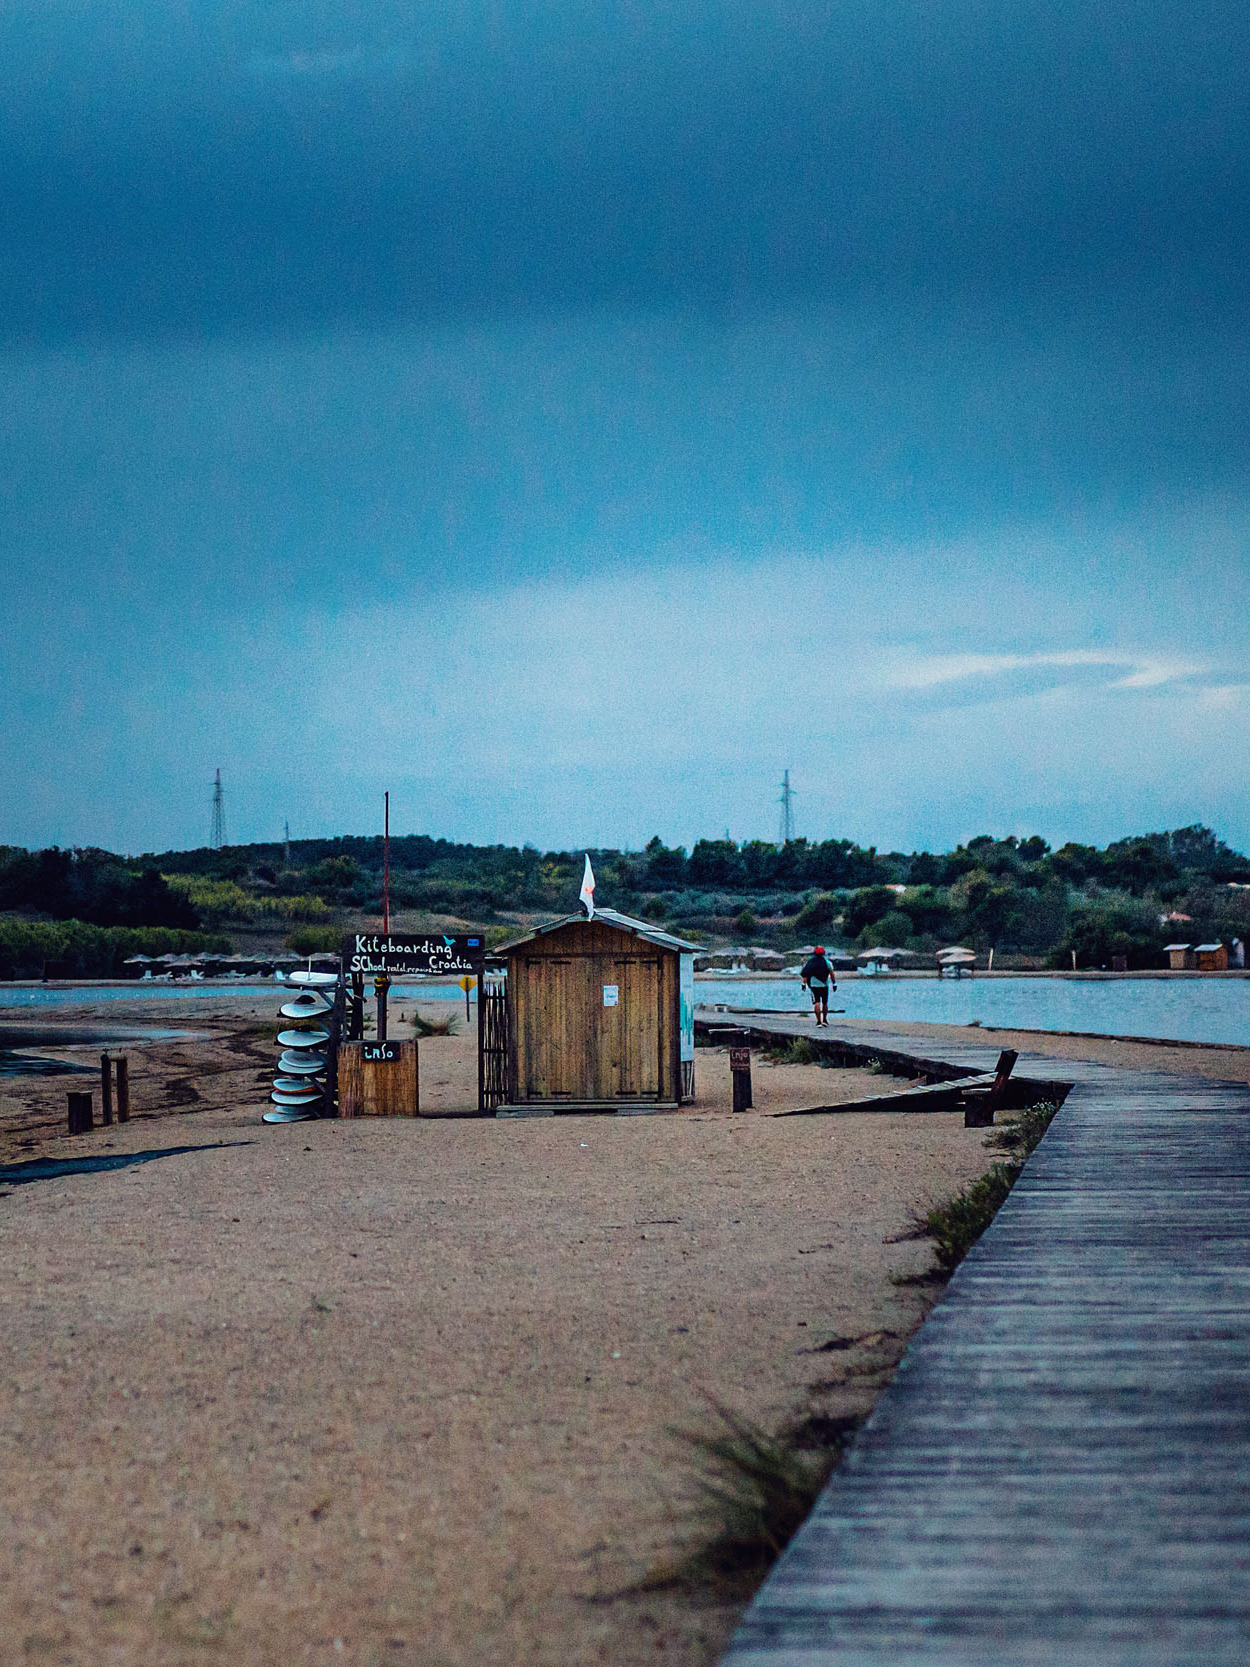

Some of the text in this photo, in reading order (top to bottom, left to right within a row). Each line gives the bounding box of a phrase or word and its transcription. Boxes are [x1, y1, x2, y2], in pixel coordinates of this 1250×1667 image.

[355, 934, 452, 959] Kiteboarding
[428, 955, 473, 970] Croatia
[364, 1043, 393, 1059] info
